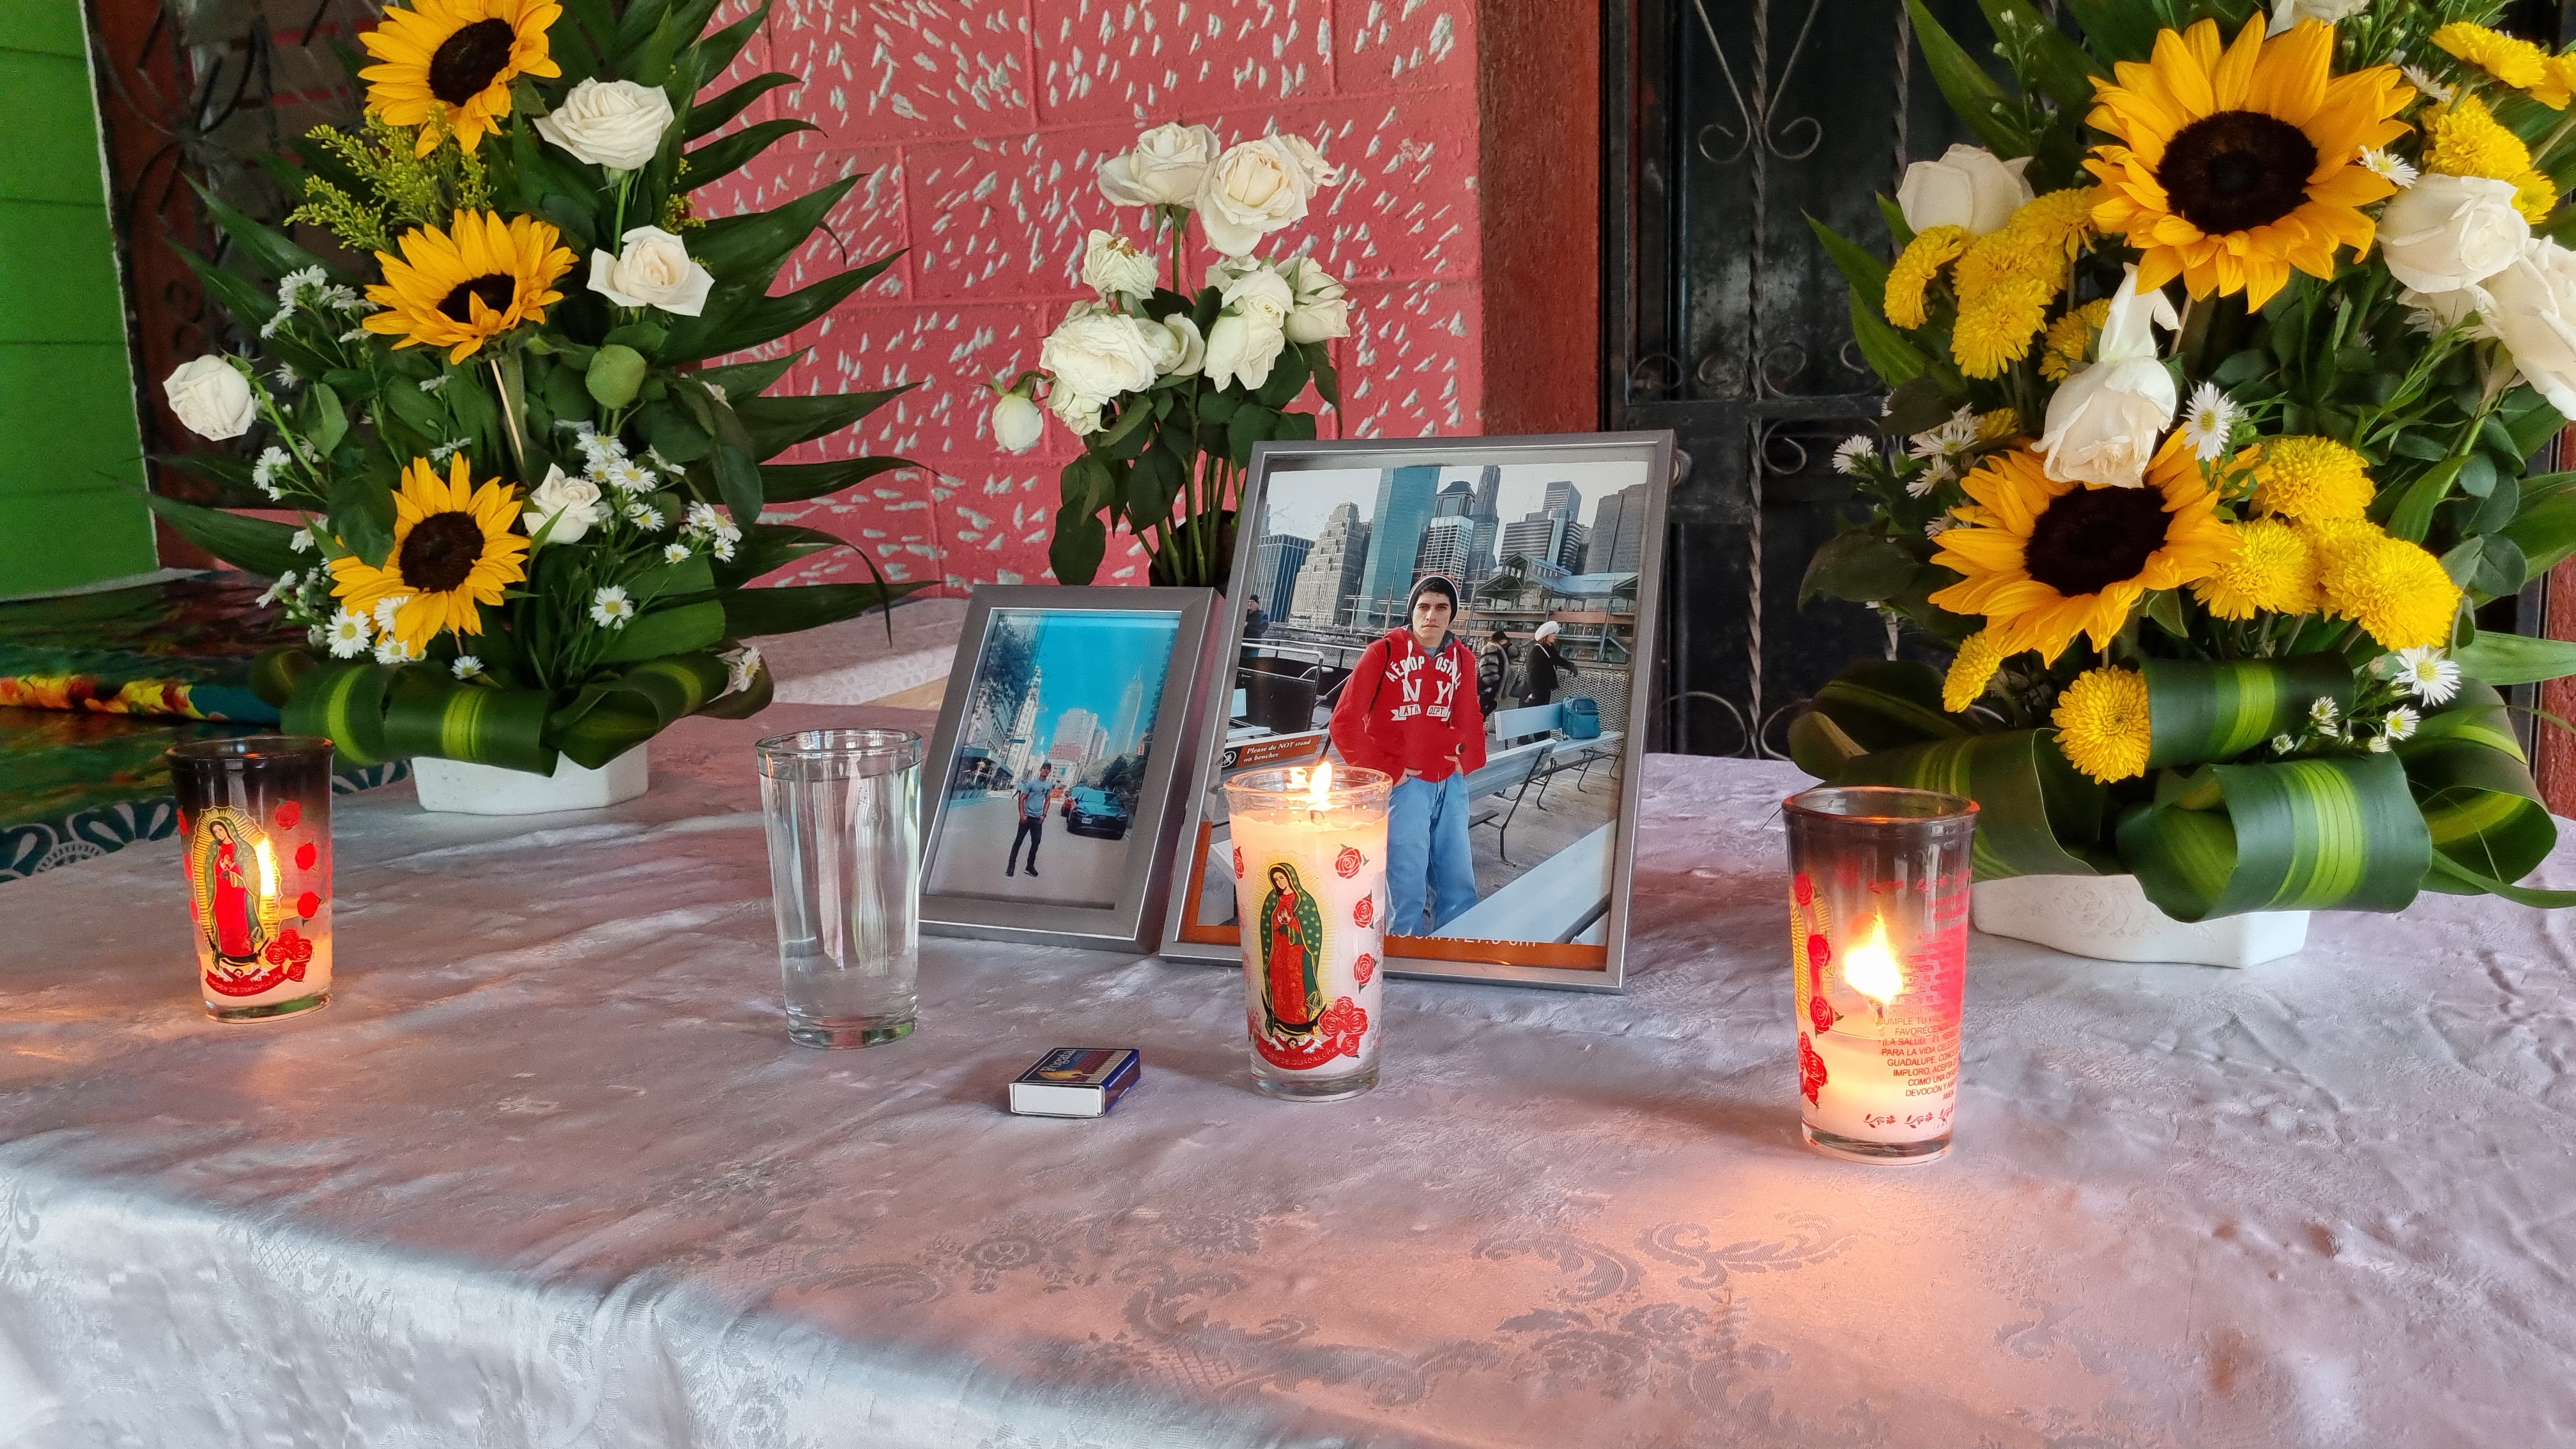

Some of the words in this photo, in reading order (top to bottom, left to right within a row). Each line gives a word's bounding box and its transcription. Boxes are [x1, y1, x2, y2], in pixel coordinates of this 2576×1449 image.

[1246, 746, 1267, 755] Please
[1278, 741, 1295, 749] NOT
[1295, 739, 1312, 747] stand
[1254, 752, 1279, 761] benches
[1917, 1016, 1928, 1025] TU
[1919, 1046, 1935, 1055] VIDA
[1908, 1077, 1931, 1087] COMO
[1933, 1074, 1945, 1083] UNA
